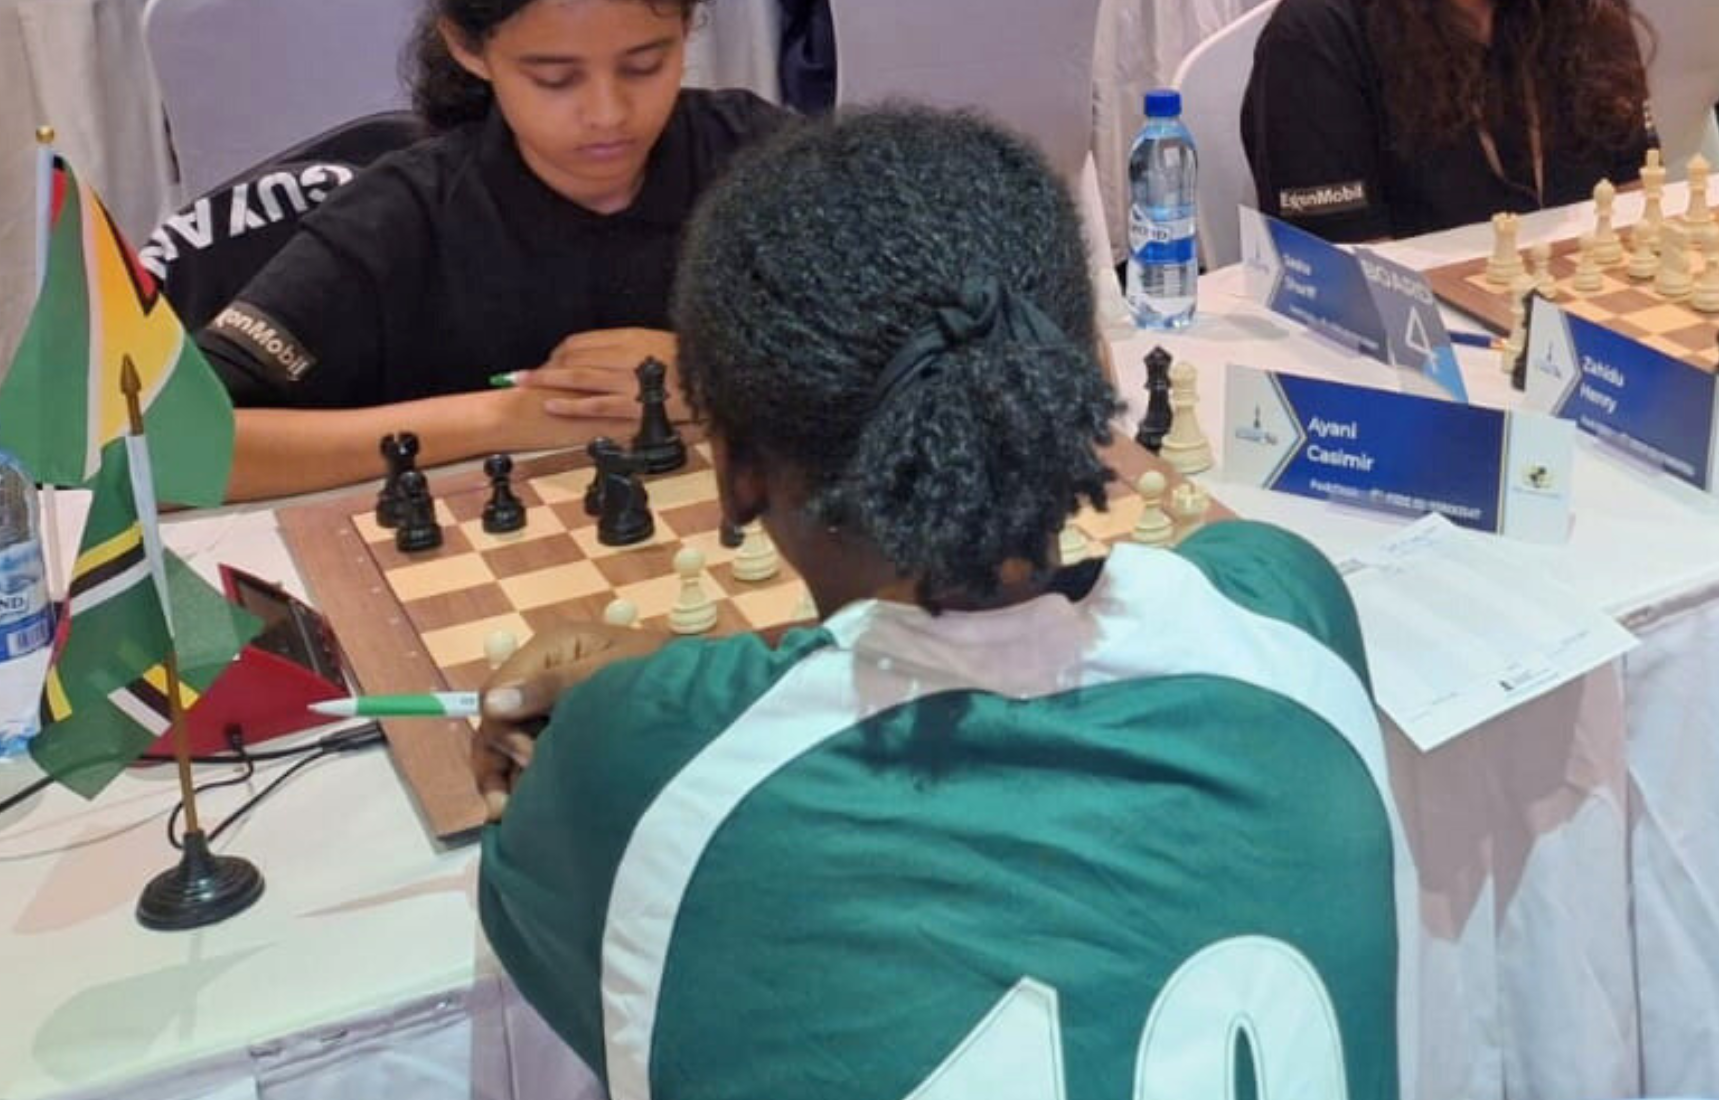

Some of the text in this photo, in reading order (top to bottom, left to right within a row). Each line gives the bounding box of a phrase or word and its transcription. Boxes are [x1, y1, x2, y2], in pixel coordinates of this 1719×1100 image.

[1579, 382, 1617, 415] Henry
[1307, 416, 1358, 440] Ayani
[1306, 445, 1376, 473] Casimir
